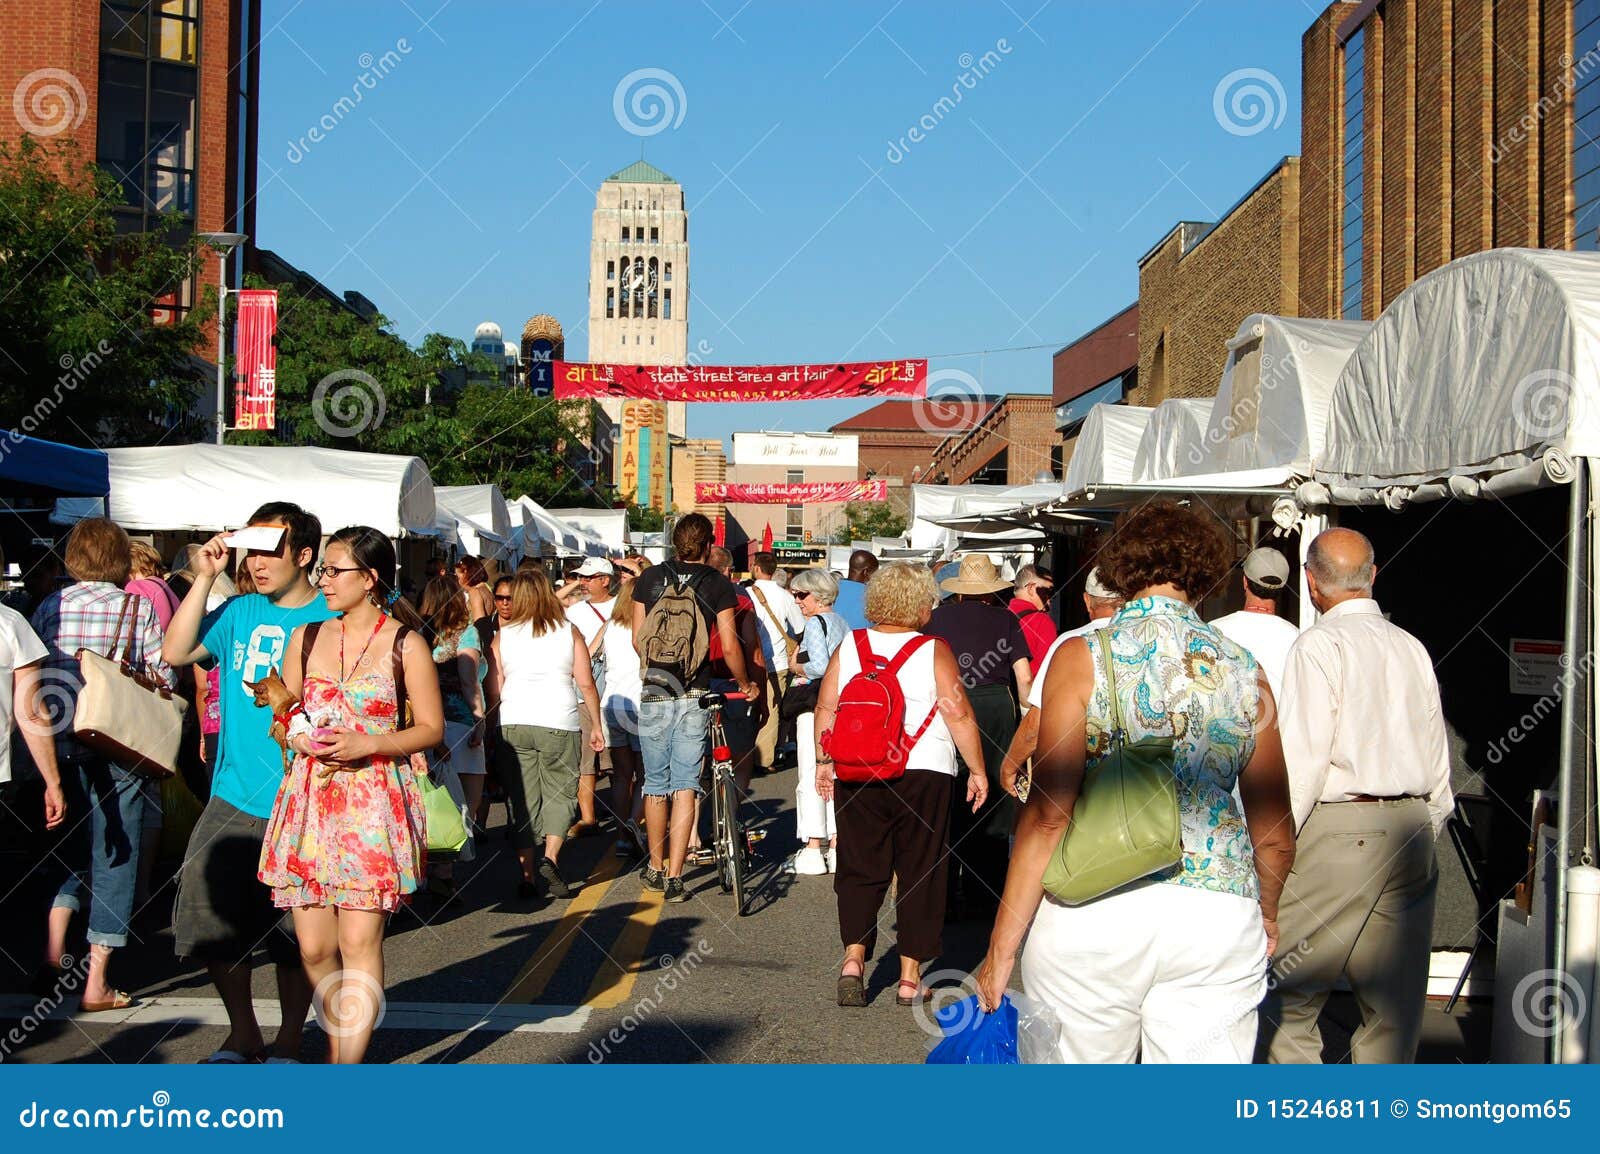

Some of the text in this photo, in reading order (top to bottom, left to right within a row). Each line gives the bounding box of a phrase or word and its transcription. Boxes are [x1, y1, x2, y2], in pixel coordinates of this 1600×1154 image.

[566, 365, 600, 382] art
[777, 366, 800, 382] art
[804, 365, 829, 382] fair
[865, 362, 900, 383] art
[236, 412, 275, 430] art
[623, 406, 636, 500] STAT
